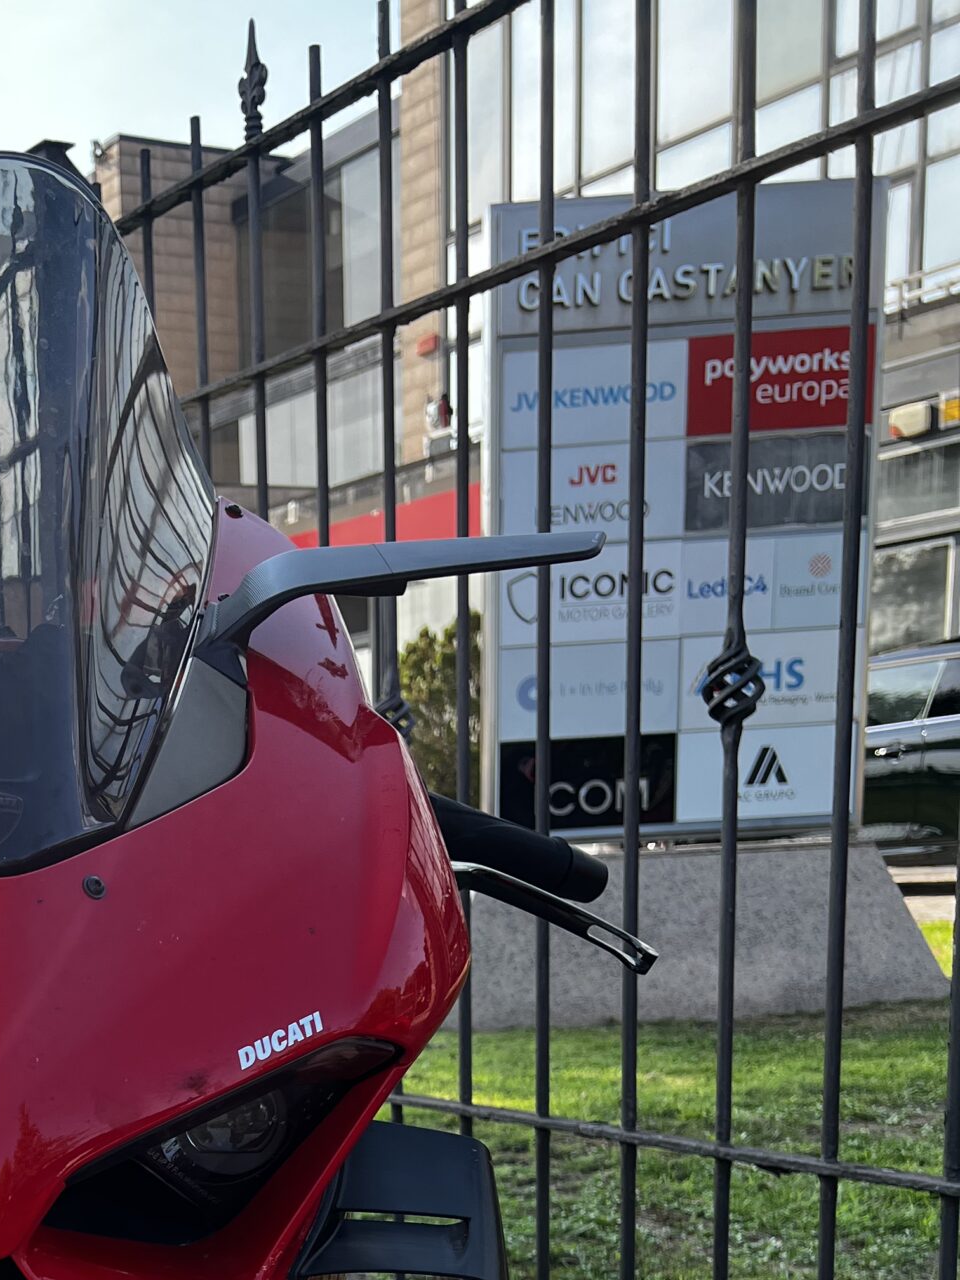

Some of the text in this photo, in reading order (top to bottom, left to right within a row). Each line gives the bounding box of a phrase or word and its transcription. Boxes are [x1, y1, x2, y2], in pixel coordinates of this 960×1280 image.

[518, 271, 602, 311] CAN
[704, 348, 851, 386] poyworks
[511, 382, 677, 412] JVKENWOOD
[756, 378, 851, 407] europa
[569, 464, 617, 486] JVC
[535, 499, 651, 526] ENWOO
[687, 574, 768, 599] LedC4
[558, 608, 609, 623] MOTOR
[237, 1010, 324, 1070] DUCATI
